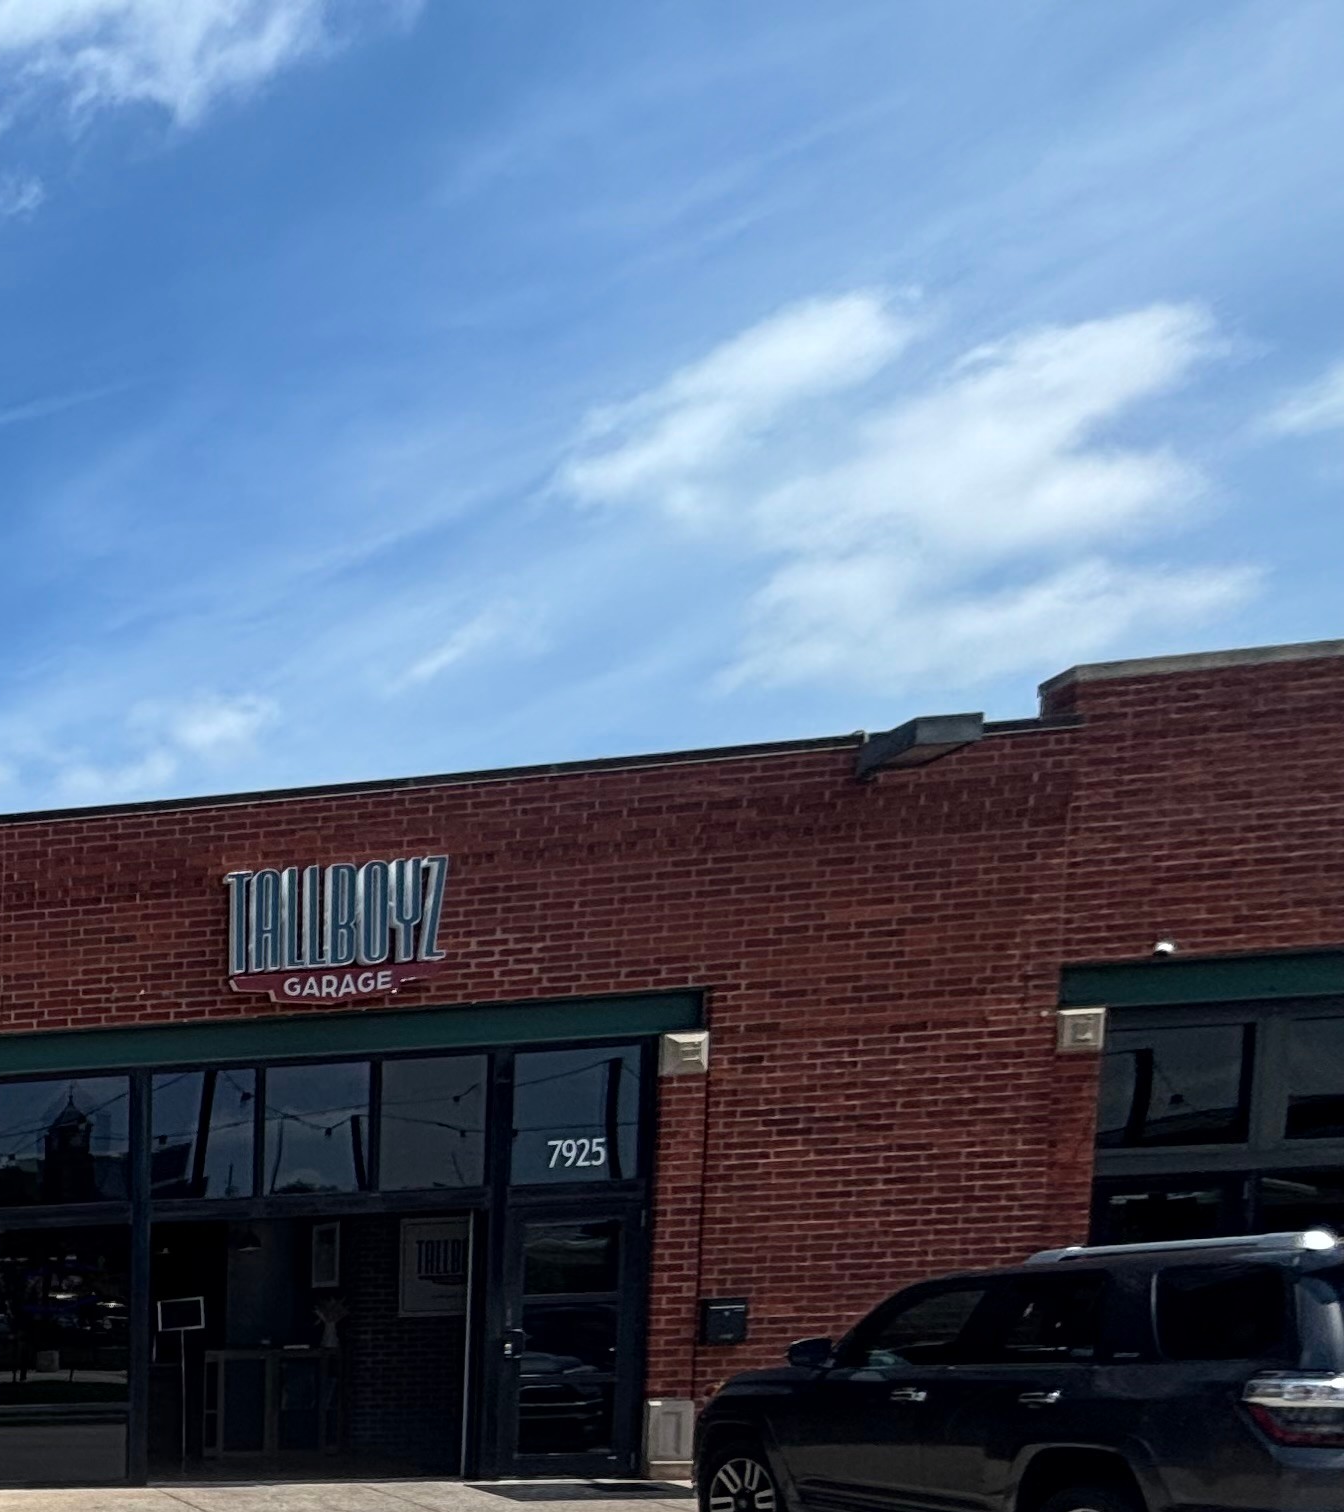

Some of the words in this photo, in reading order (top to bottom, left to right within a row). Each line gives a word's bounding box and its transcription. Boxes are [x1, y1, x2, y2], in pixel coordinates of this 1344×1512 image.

[223, 854, 449, 975] TALLBOYZ
[283, 970, 393, 998] GARAGE
[547, 1137, 606, 1169] 7925
